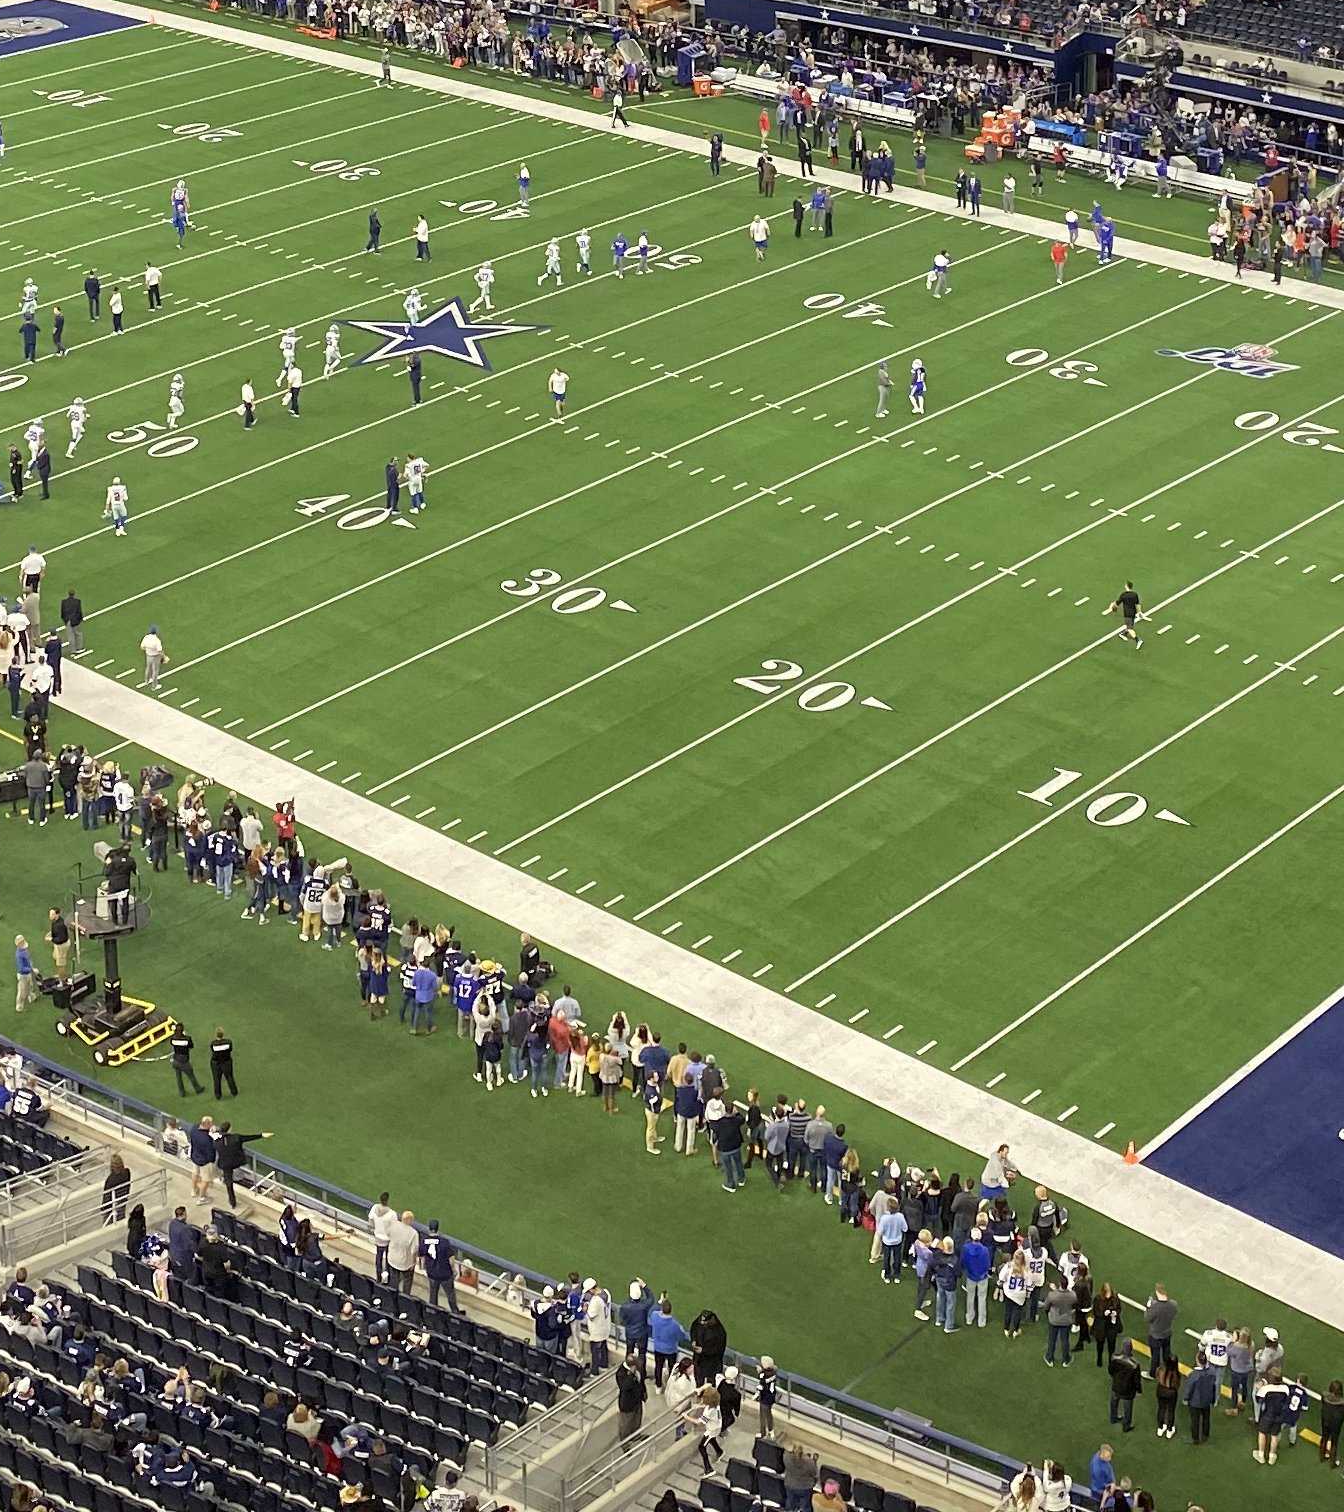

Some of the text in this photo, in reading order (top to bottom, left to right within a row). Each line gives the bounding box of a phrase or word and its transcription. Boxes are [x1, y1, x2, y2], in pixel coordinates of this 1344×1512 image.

[50, 88, 114, 109] 10
[186, 121, 244, 144] 20
[308, 157, 382, 183] 30
[802, 292, 886, 320] 40
[1003, 347, 1088, 379] 30
[107, 419, 201, 458] 50
[1233, 410, 1325, 450] 20
[293, 492, 394, 532] 40
[500, 567, 608, 615] 30
[733, 657, 857, 713] 20
[1017, 765, 1150, 828] 10
[308, 889, 323, 903] 82
[458, 983, 472, 999] 17
